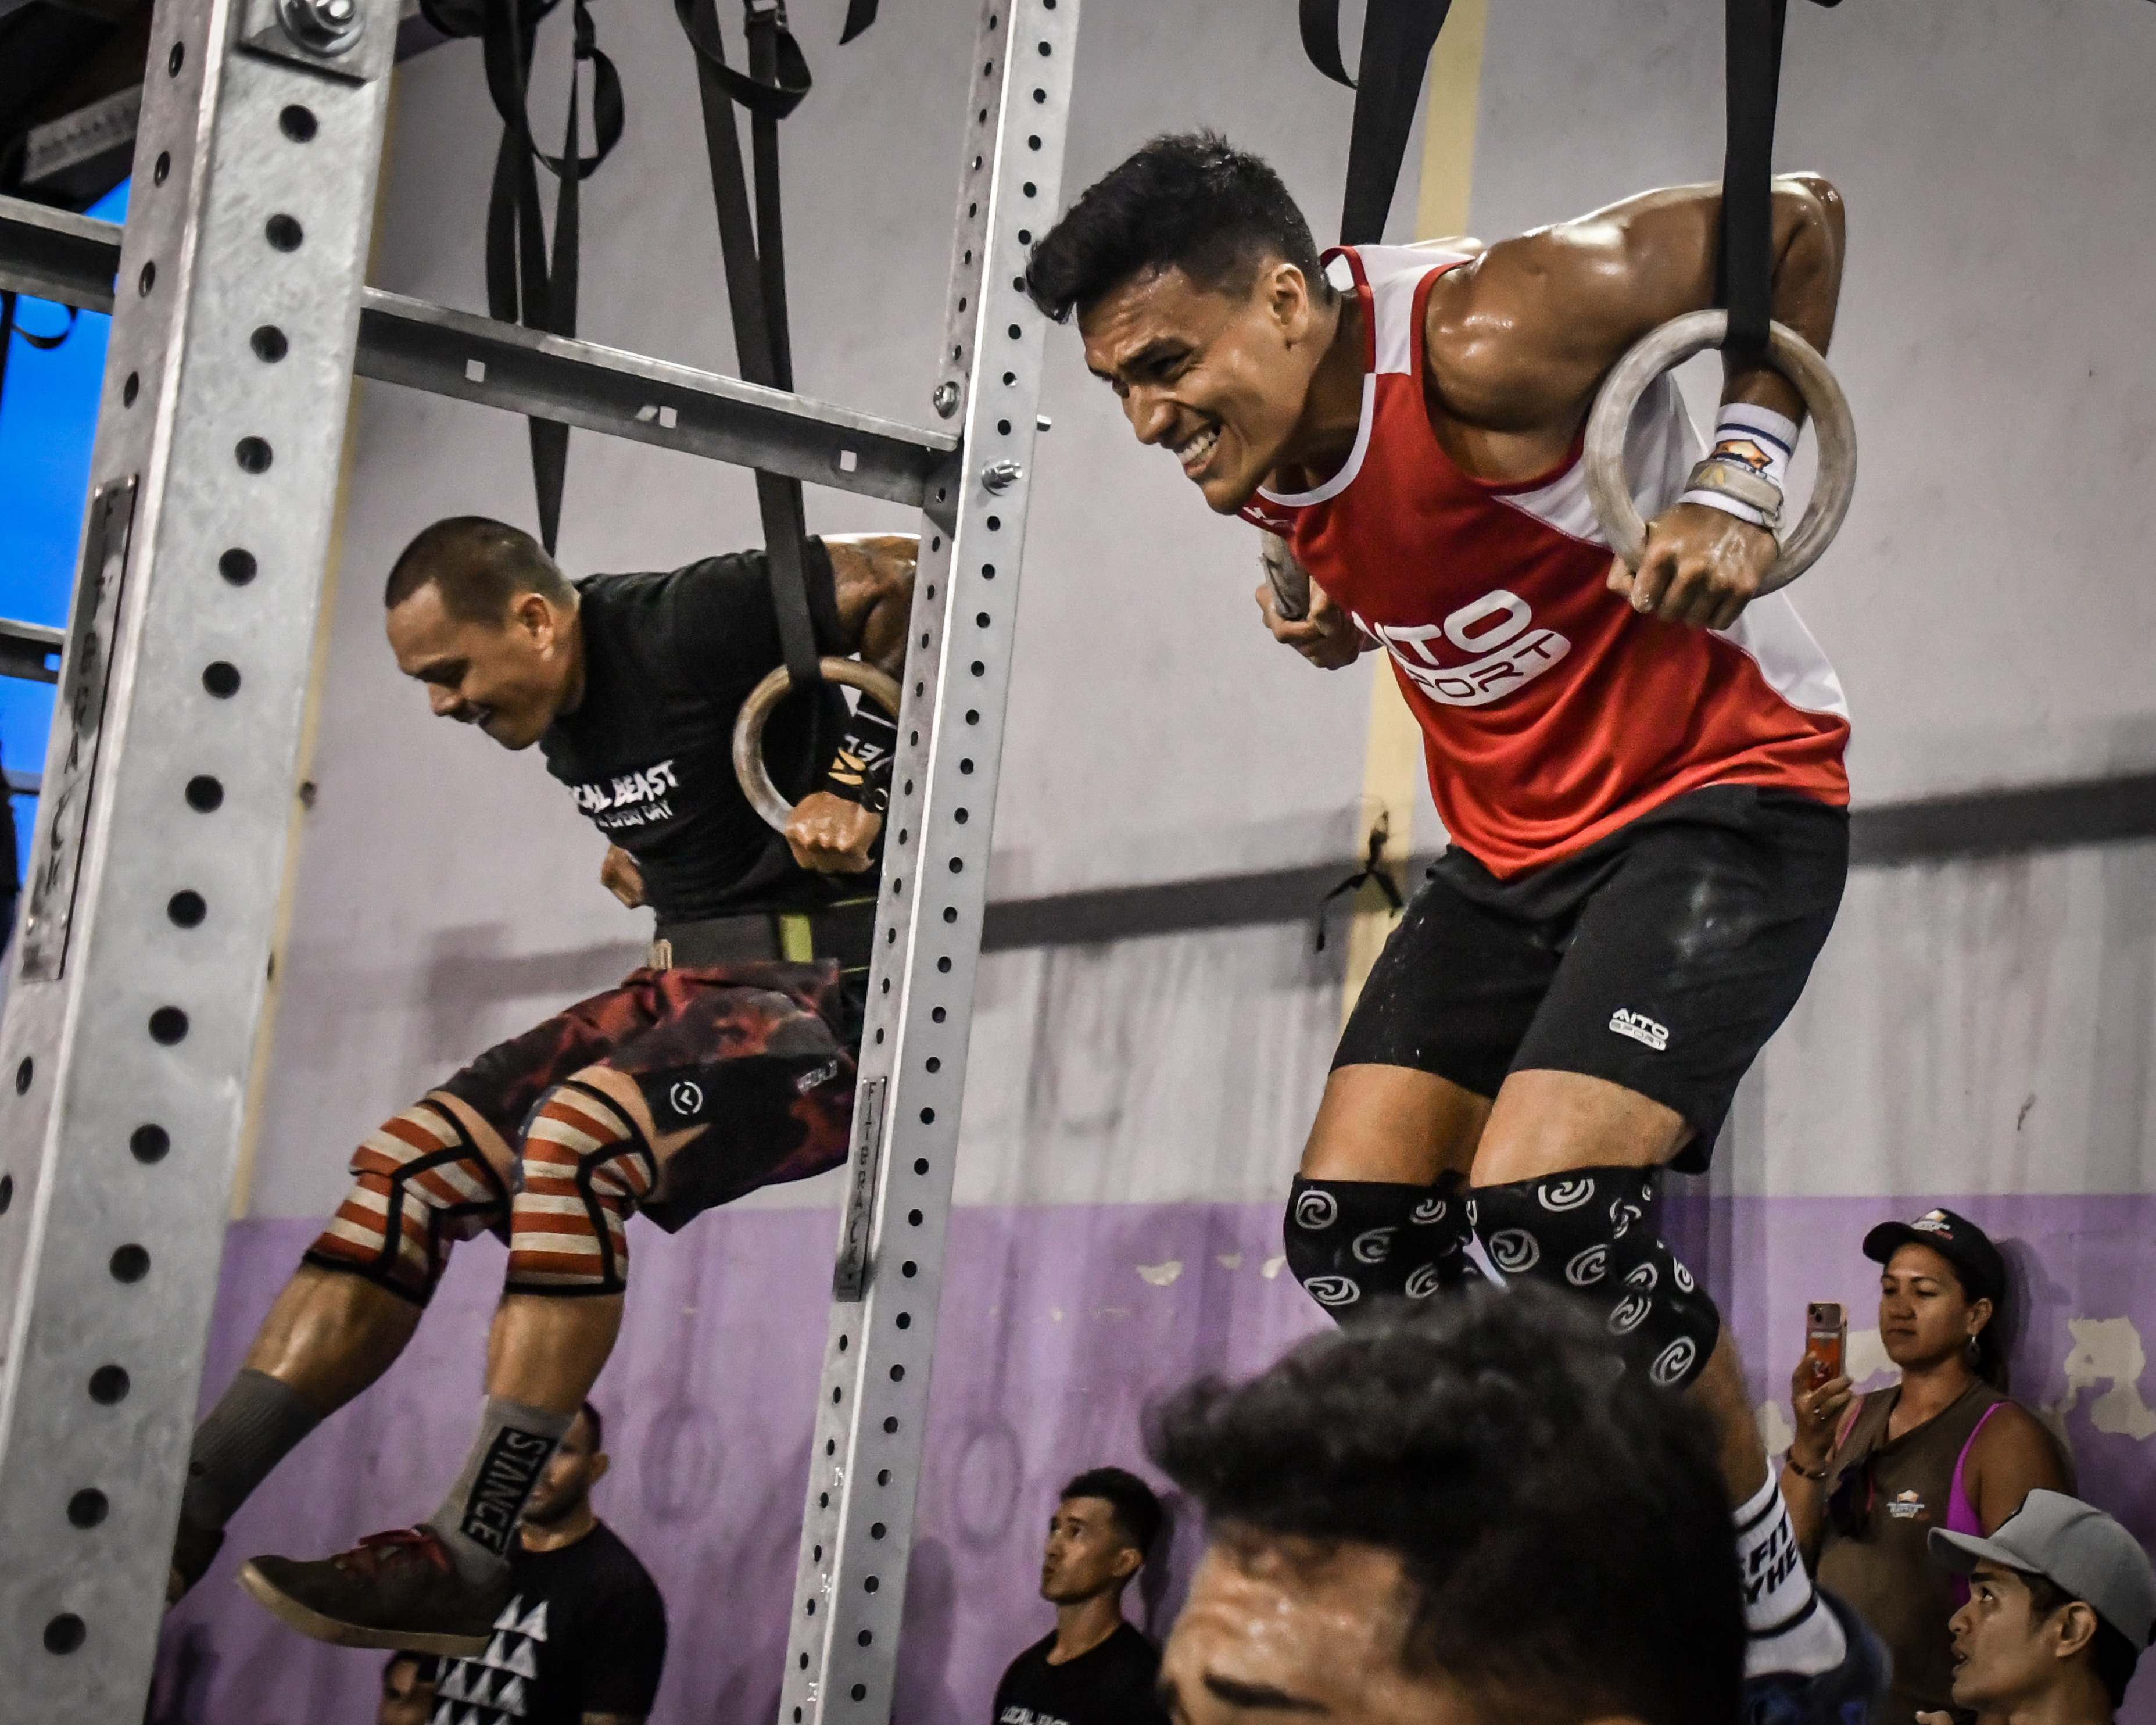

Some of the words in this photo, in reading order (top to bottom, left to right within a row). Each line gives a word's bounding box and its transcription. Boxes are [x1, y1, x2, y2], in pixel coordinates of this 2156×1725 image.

[612, 760, 679, 807] BEAST
[1612, 1008, 1669, 1040] AITO
[468, 1431, 548, 1548] STANCE
